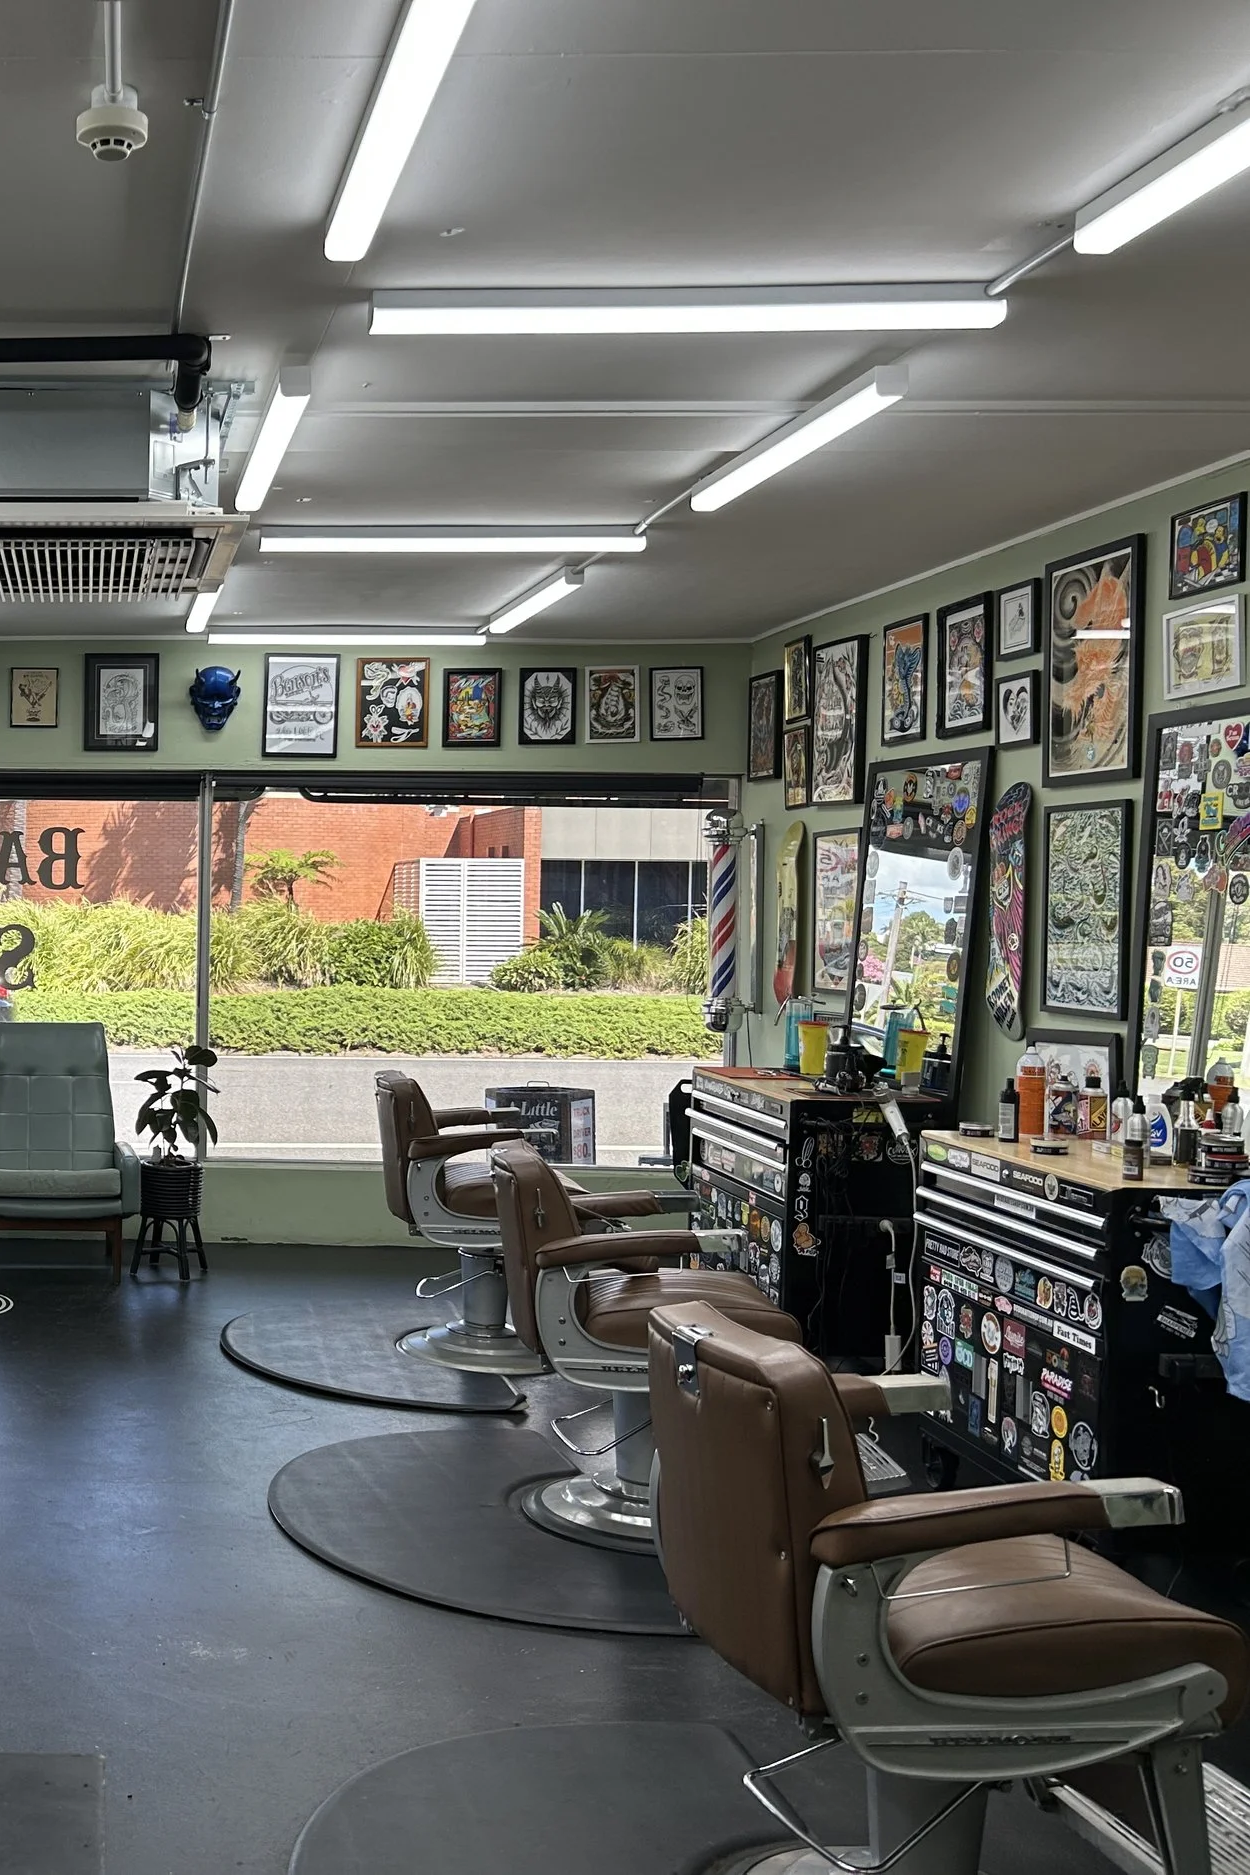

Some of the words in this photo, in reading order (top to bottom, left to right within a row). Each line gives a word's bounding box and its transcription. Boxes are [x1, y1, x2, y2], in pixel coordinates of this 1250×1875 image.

[521, 1100, 558, 1116] Little
[971, 1157, 999, 1173] SEAFOOD
[1012, 1170, 1043, 1187] SEAFOOD
[1056, 1325, 1070, 1340] Fast
[1071, 1332, 1092, 1350] Times
